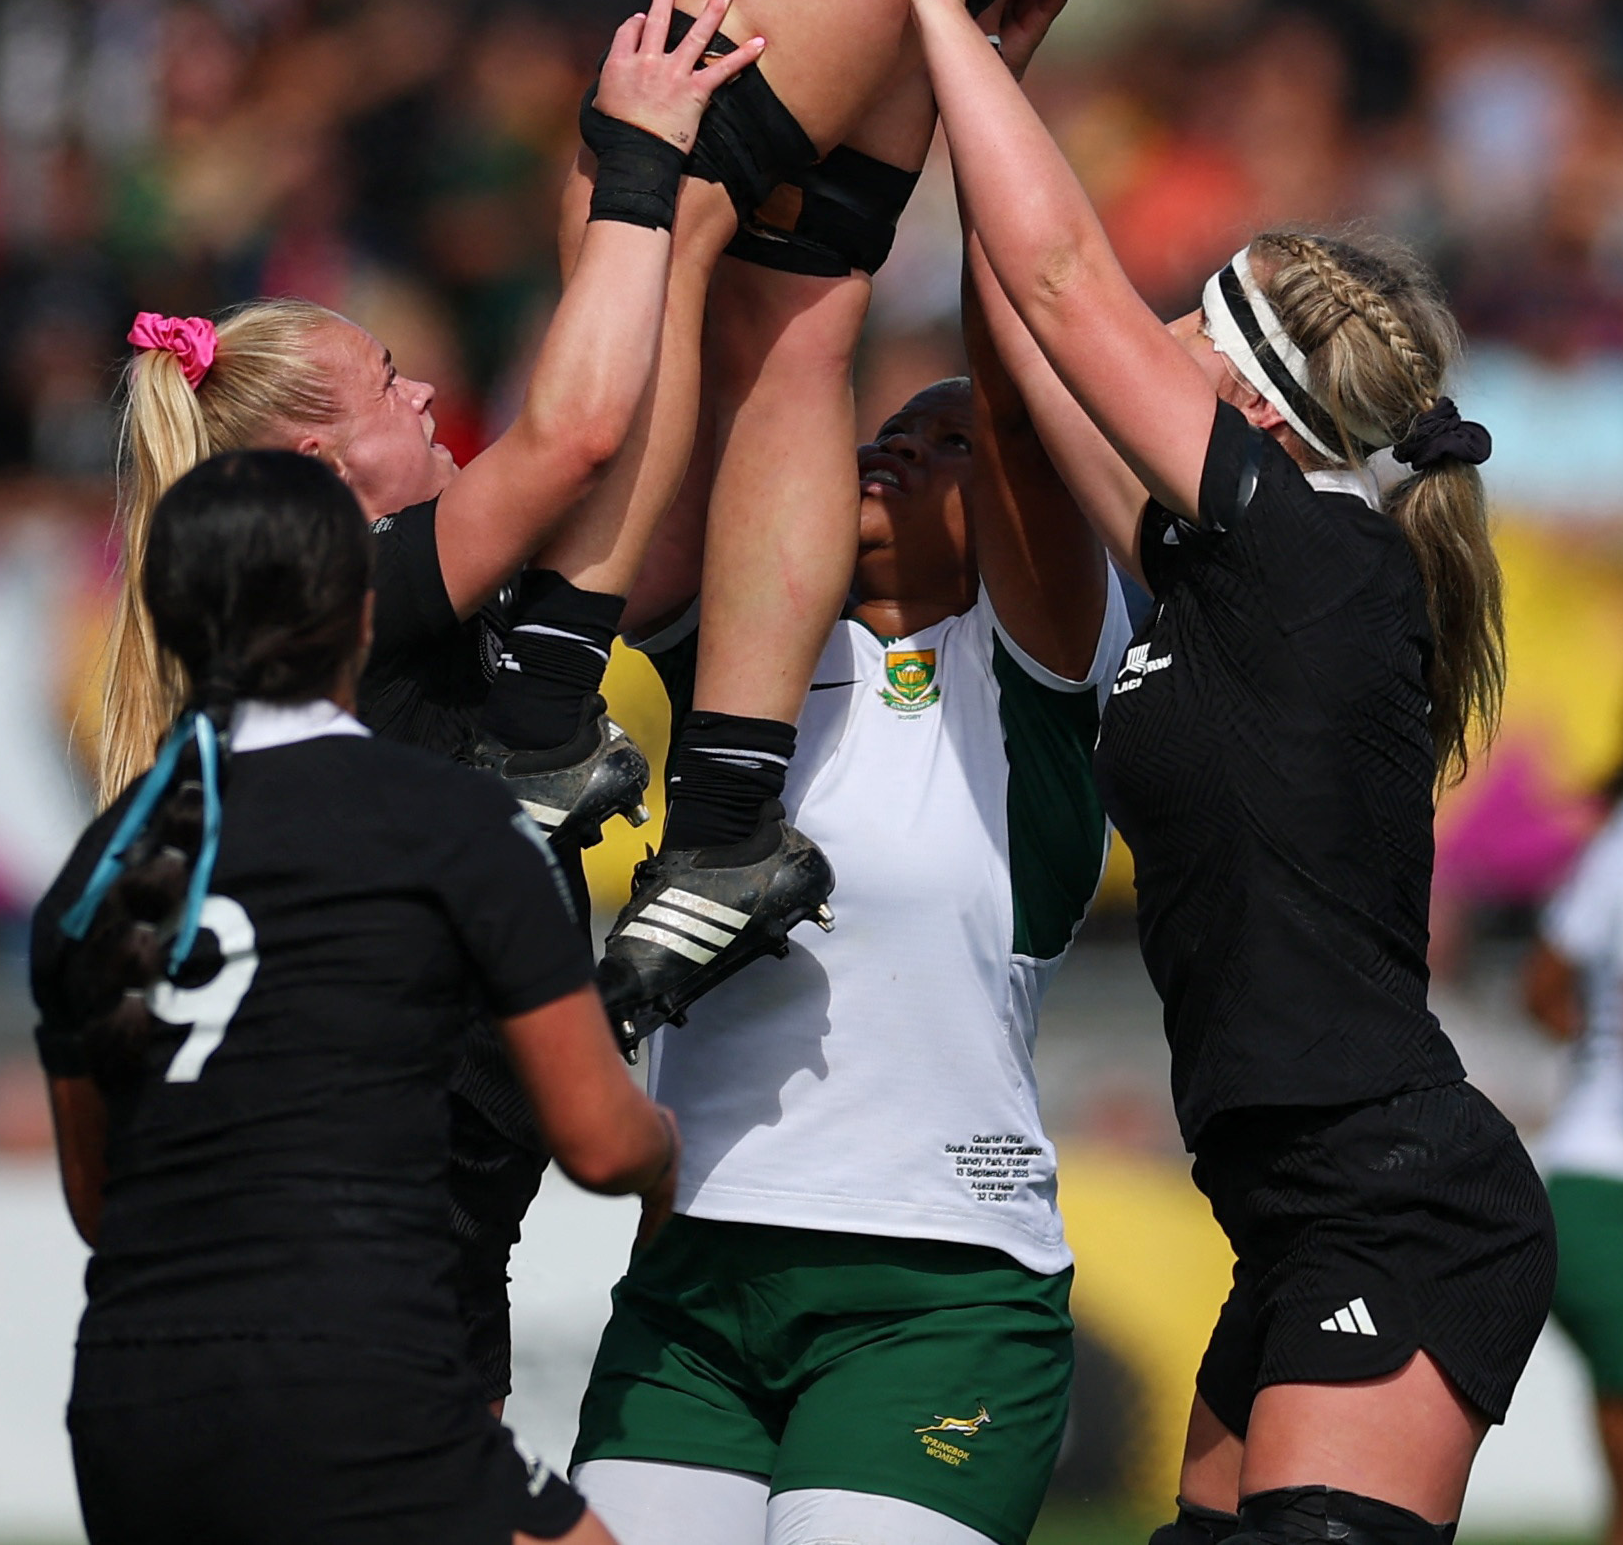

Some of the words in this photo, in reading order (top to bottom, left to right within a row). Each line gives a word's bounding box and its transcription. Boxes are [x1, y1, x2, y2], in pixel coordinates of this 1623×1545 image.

[1112, 677, 1143, 695] LAC
[144, 893, 261, 1084] 9
[956, 1156, 983, 1167] Sandy
[966, 1168, 1009, 1179] September
[1011, 1169, 1030, 1178] 2025
[920, 1434, 970, 1462] SPRINGBOK
[926, 1446, 961, 1467] WOMEN
